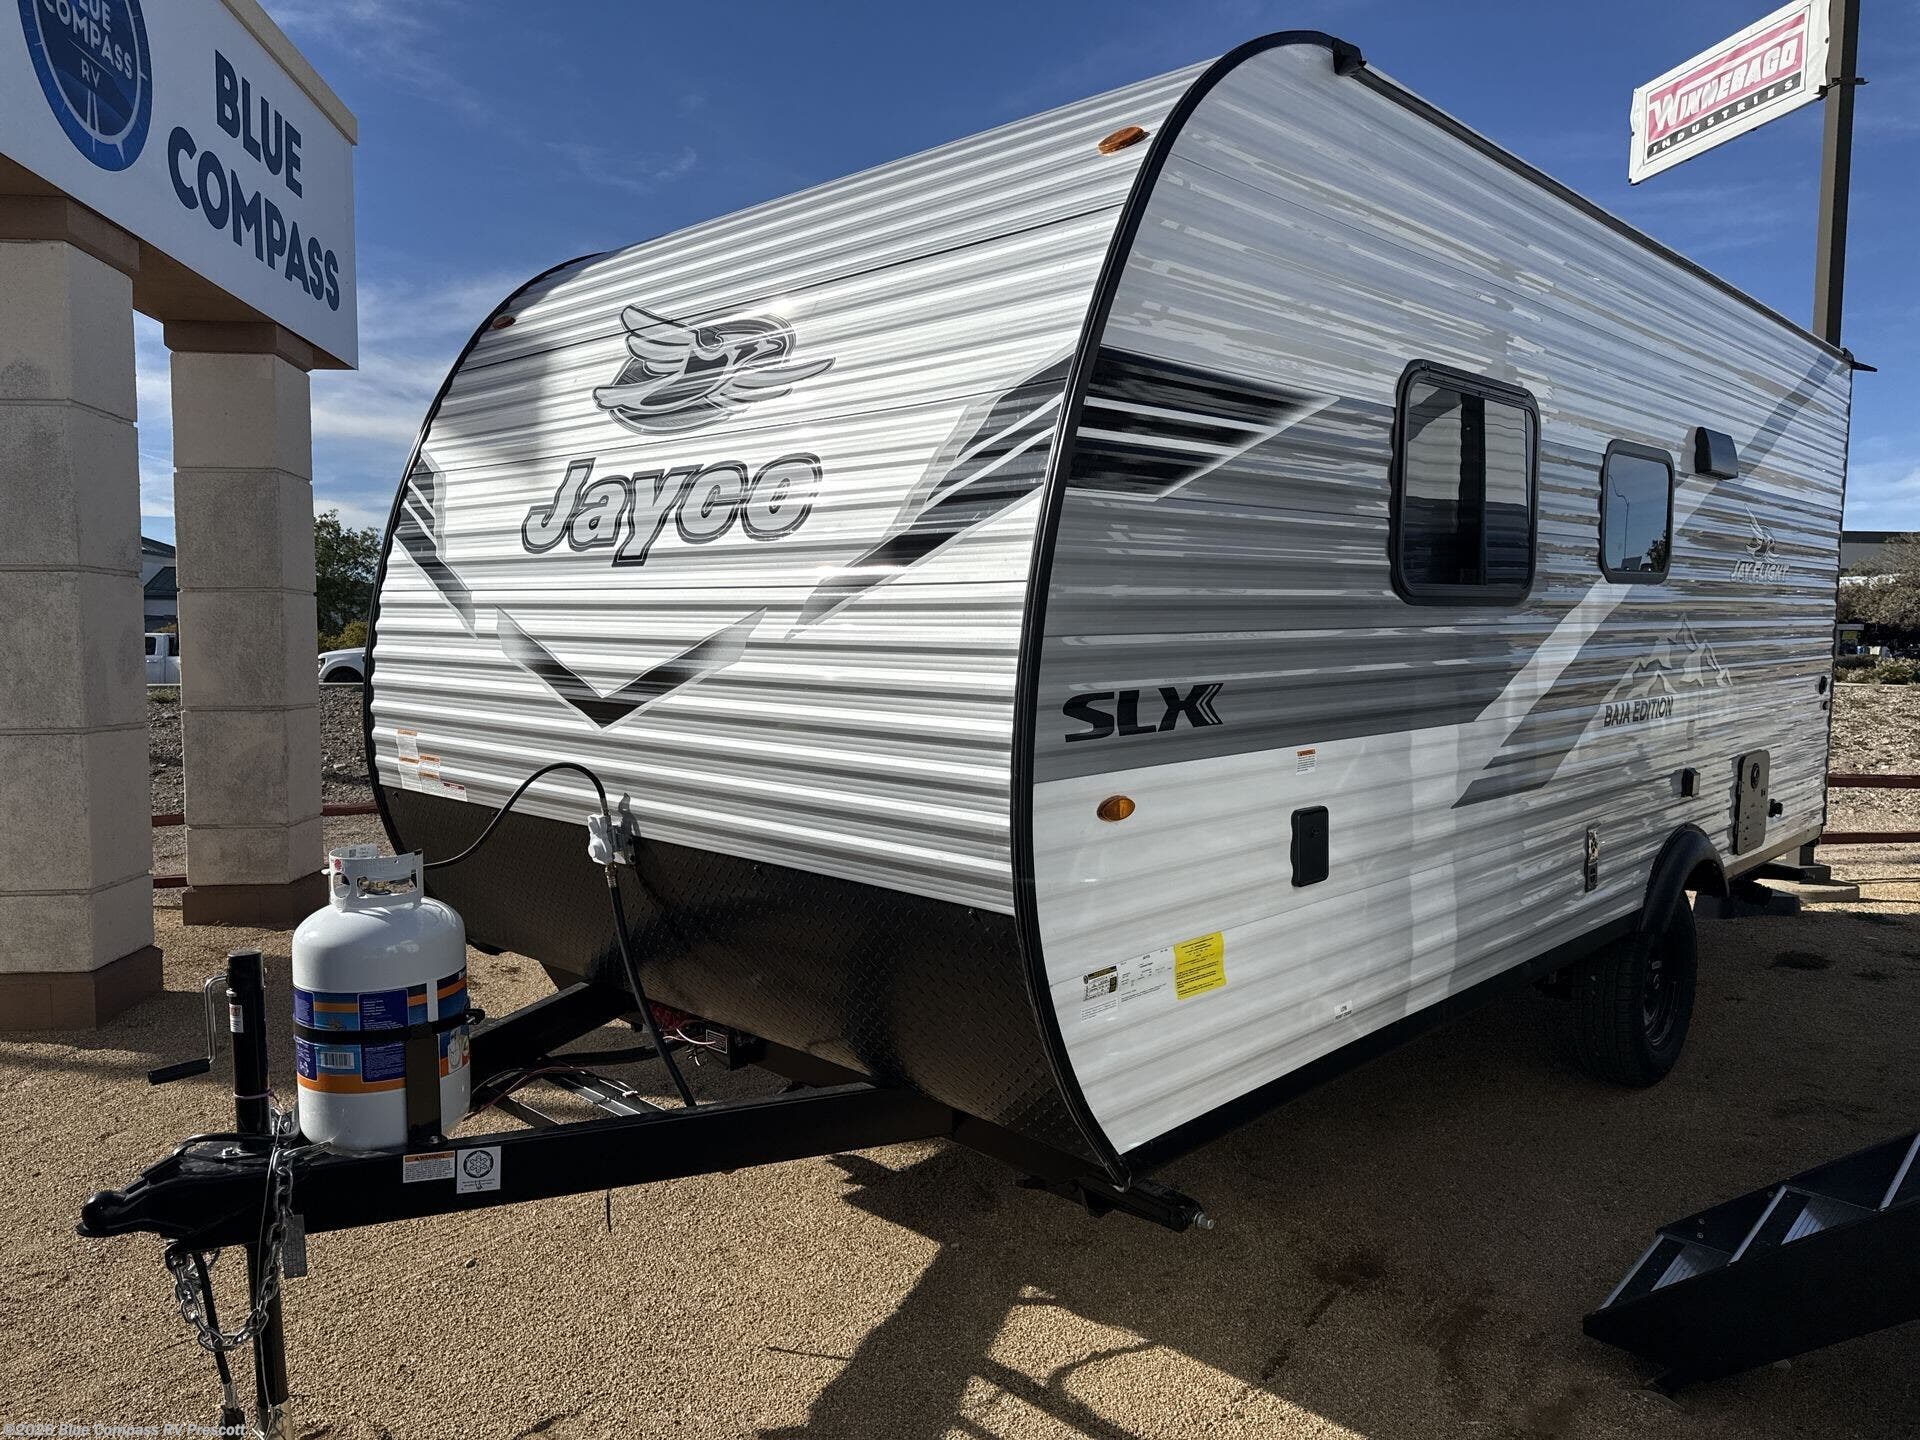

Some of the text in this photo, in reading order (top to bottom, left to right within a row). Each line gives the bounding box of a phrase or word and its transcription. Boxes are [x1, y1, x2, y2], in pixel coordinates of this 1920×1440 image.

[81, 58, 100, 88] RV
[1649, 37, 1799, 131] WINNEBAGO
[215, 49, 303, 199] BLUE
[1652, 78, 1794, 154] INDUSTRIES
[167, 126, 340, 312] COMPASS
[521, 452, 823, 567] Jayco
[1730, 560, 1791, 583] JAY FLIGHT
[1063, 683, 1224, 743] SLX
[1604, 696, 1674, 728] BAJA EDITION
